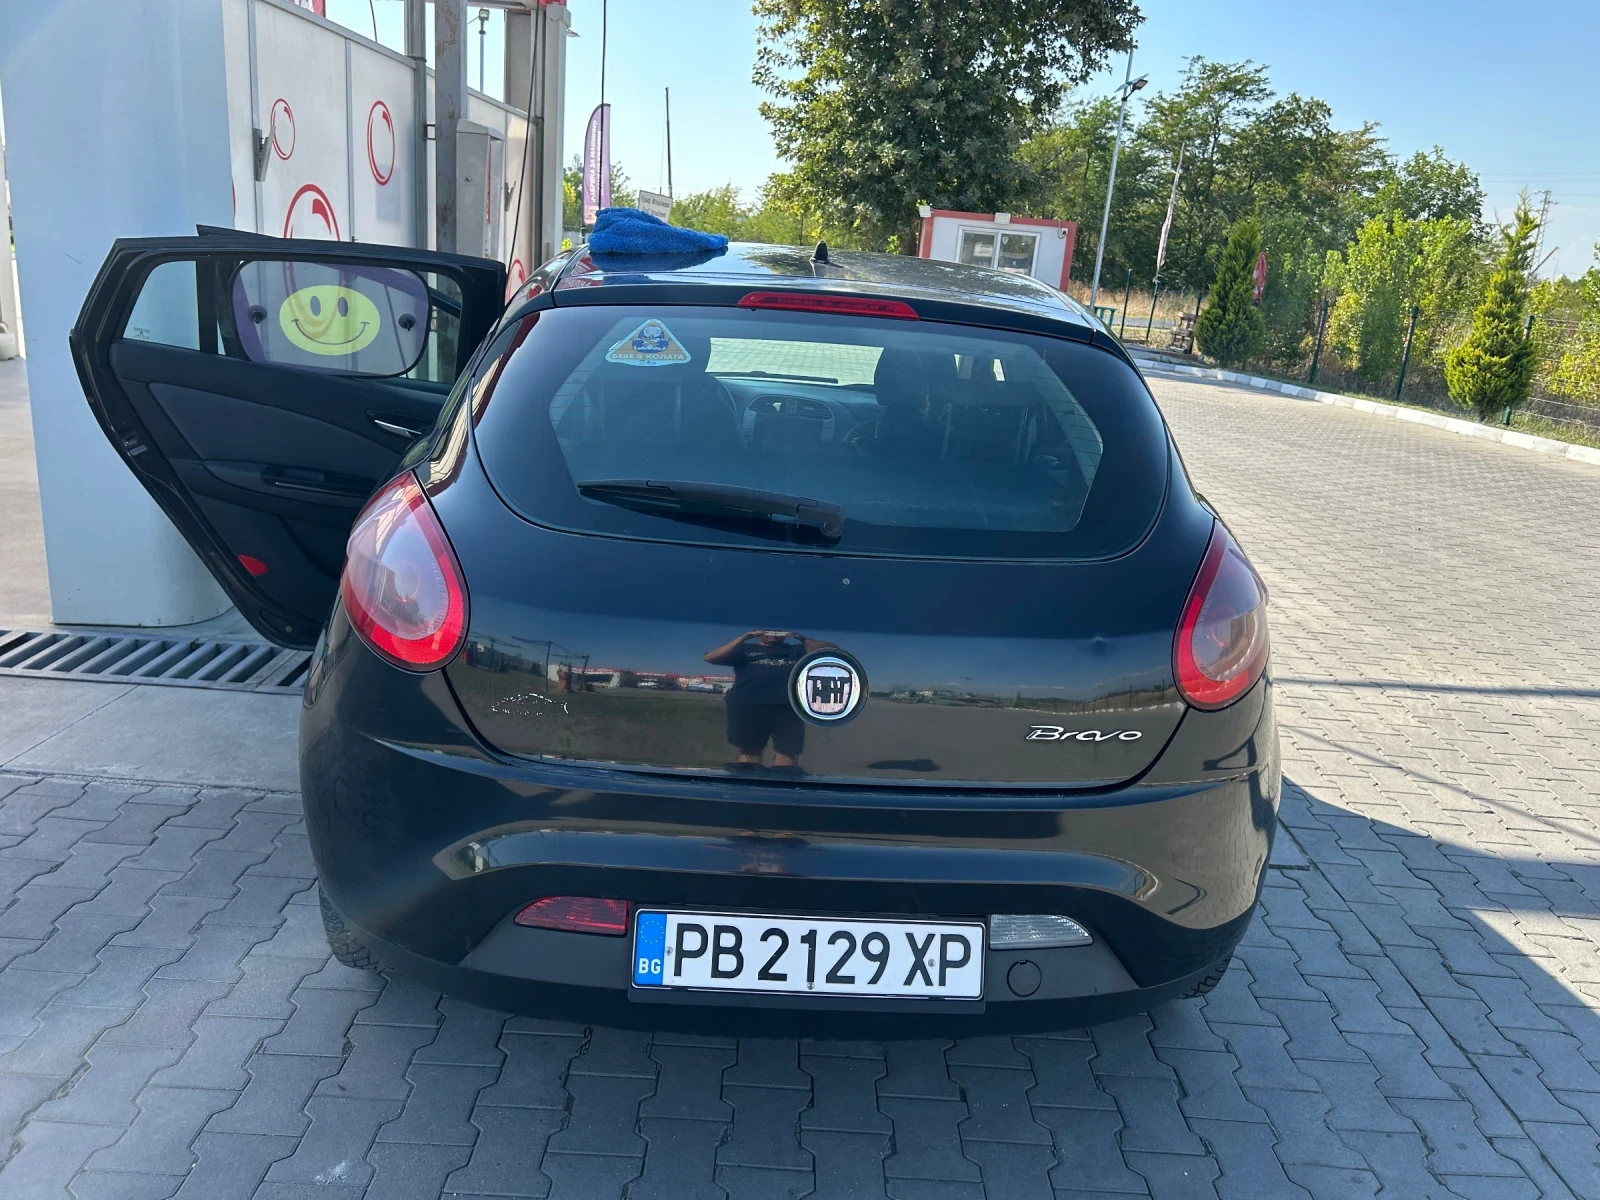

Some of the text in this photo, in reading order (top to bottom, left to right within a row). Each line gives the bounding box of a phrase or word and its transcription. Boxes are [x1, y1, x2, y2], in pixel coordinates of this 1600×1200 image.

[1025, 724, 1143, 742] Bravo
[672, 922, 972, 987] PB 2129 XP
[637, 956, 662, 975] BG
